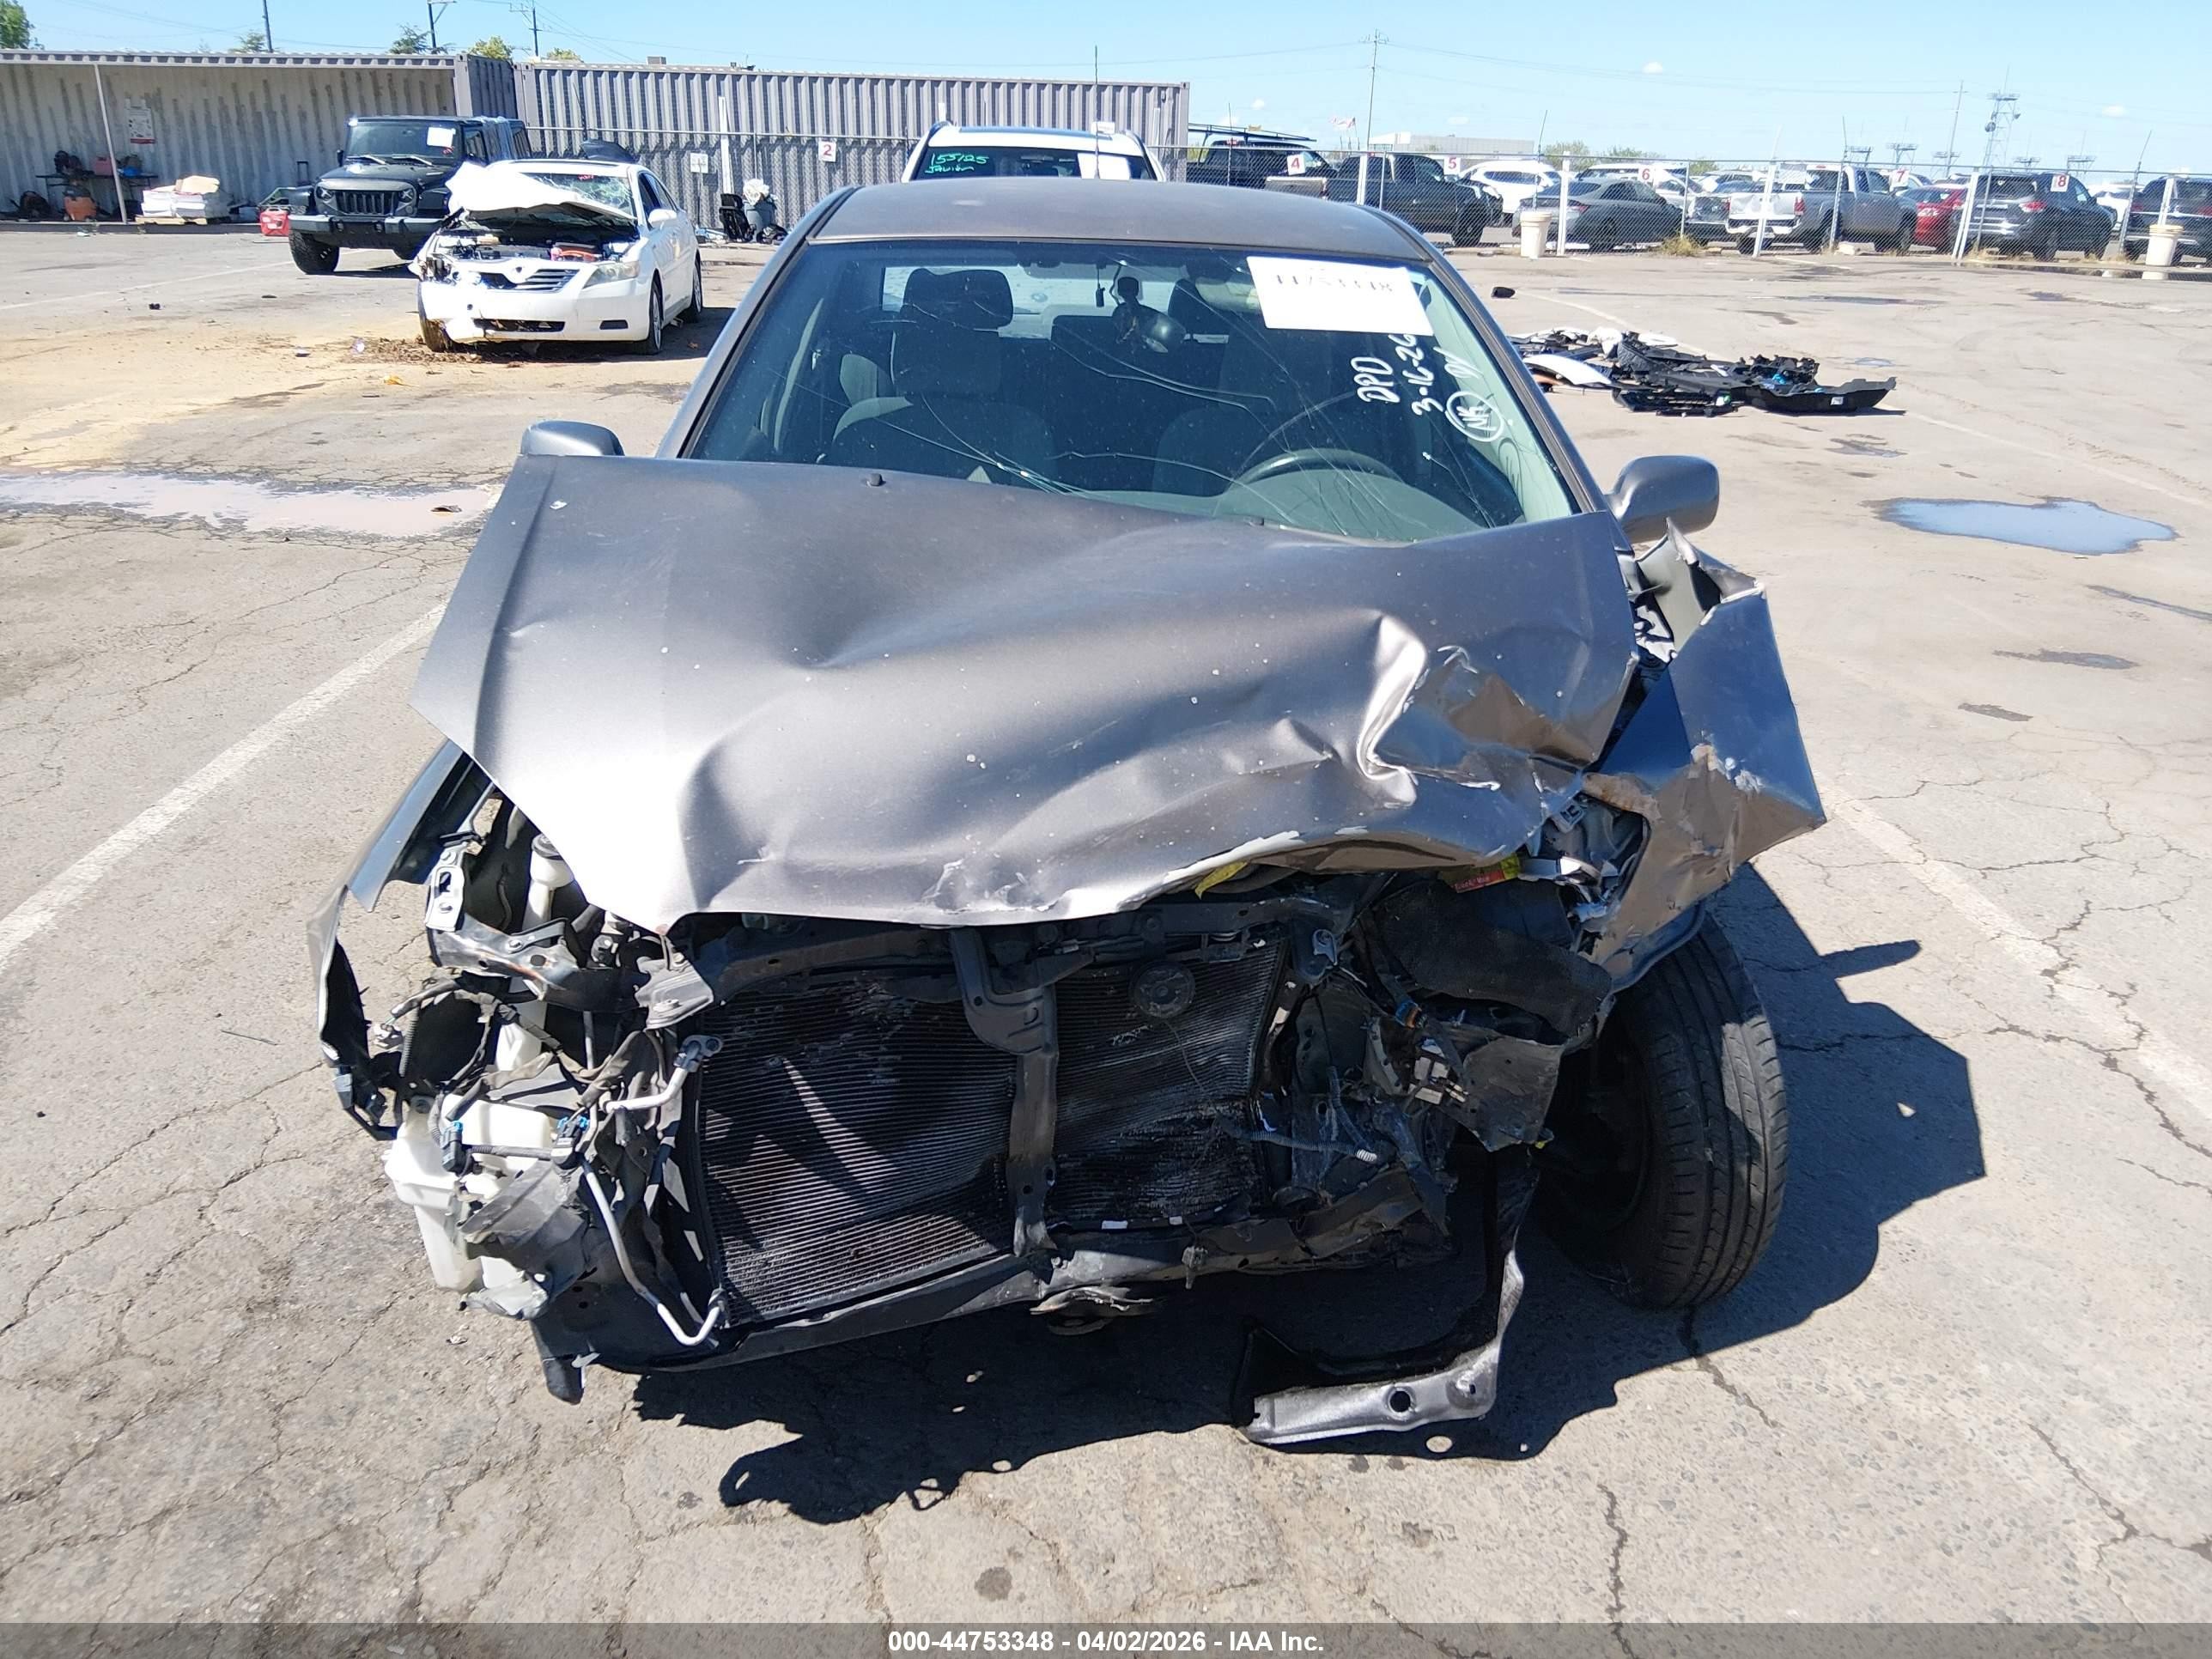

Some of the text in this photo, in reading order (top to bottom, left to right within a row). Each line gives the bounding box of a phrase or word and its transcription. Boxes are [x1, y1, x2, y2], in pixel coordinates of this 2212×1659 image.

[823, 144, 832, 155] 2
[1291, 158, 1300, 168] 4
[1449, 157, 1456, 169] 5
[1642, 168, 1650, 179] 6
[1896, 171, 1905, 182] 7
[2057, 175, 2066, 187] 8
